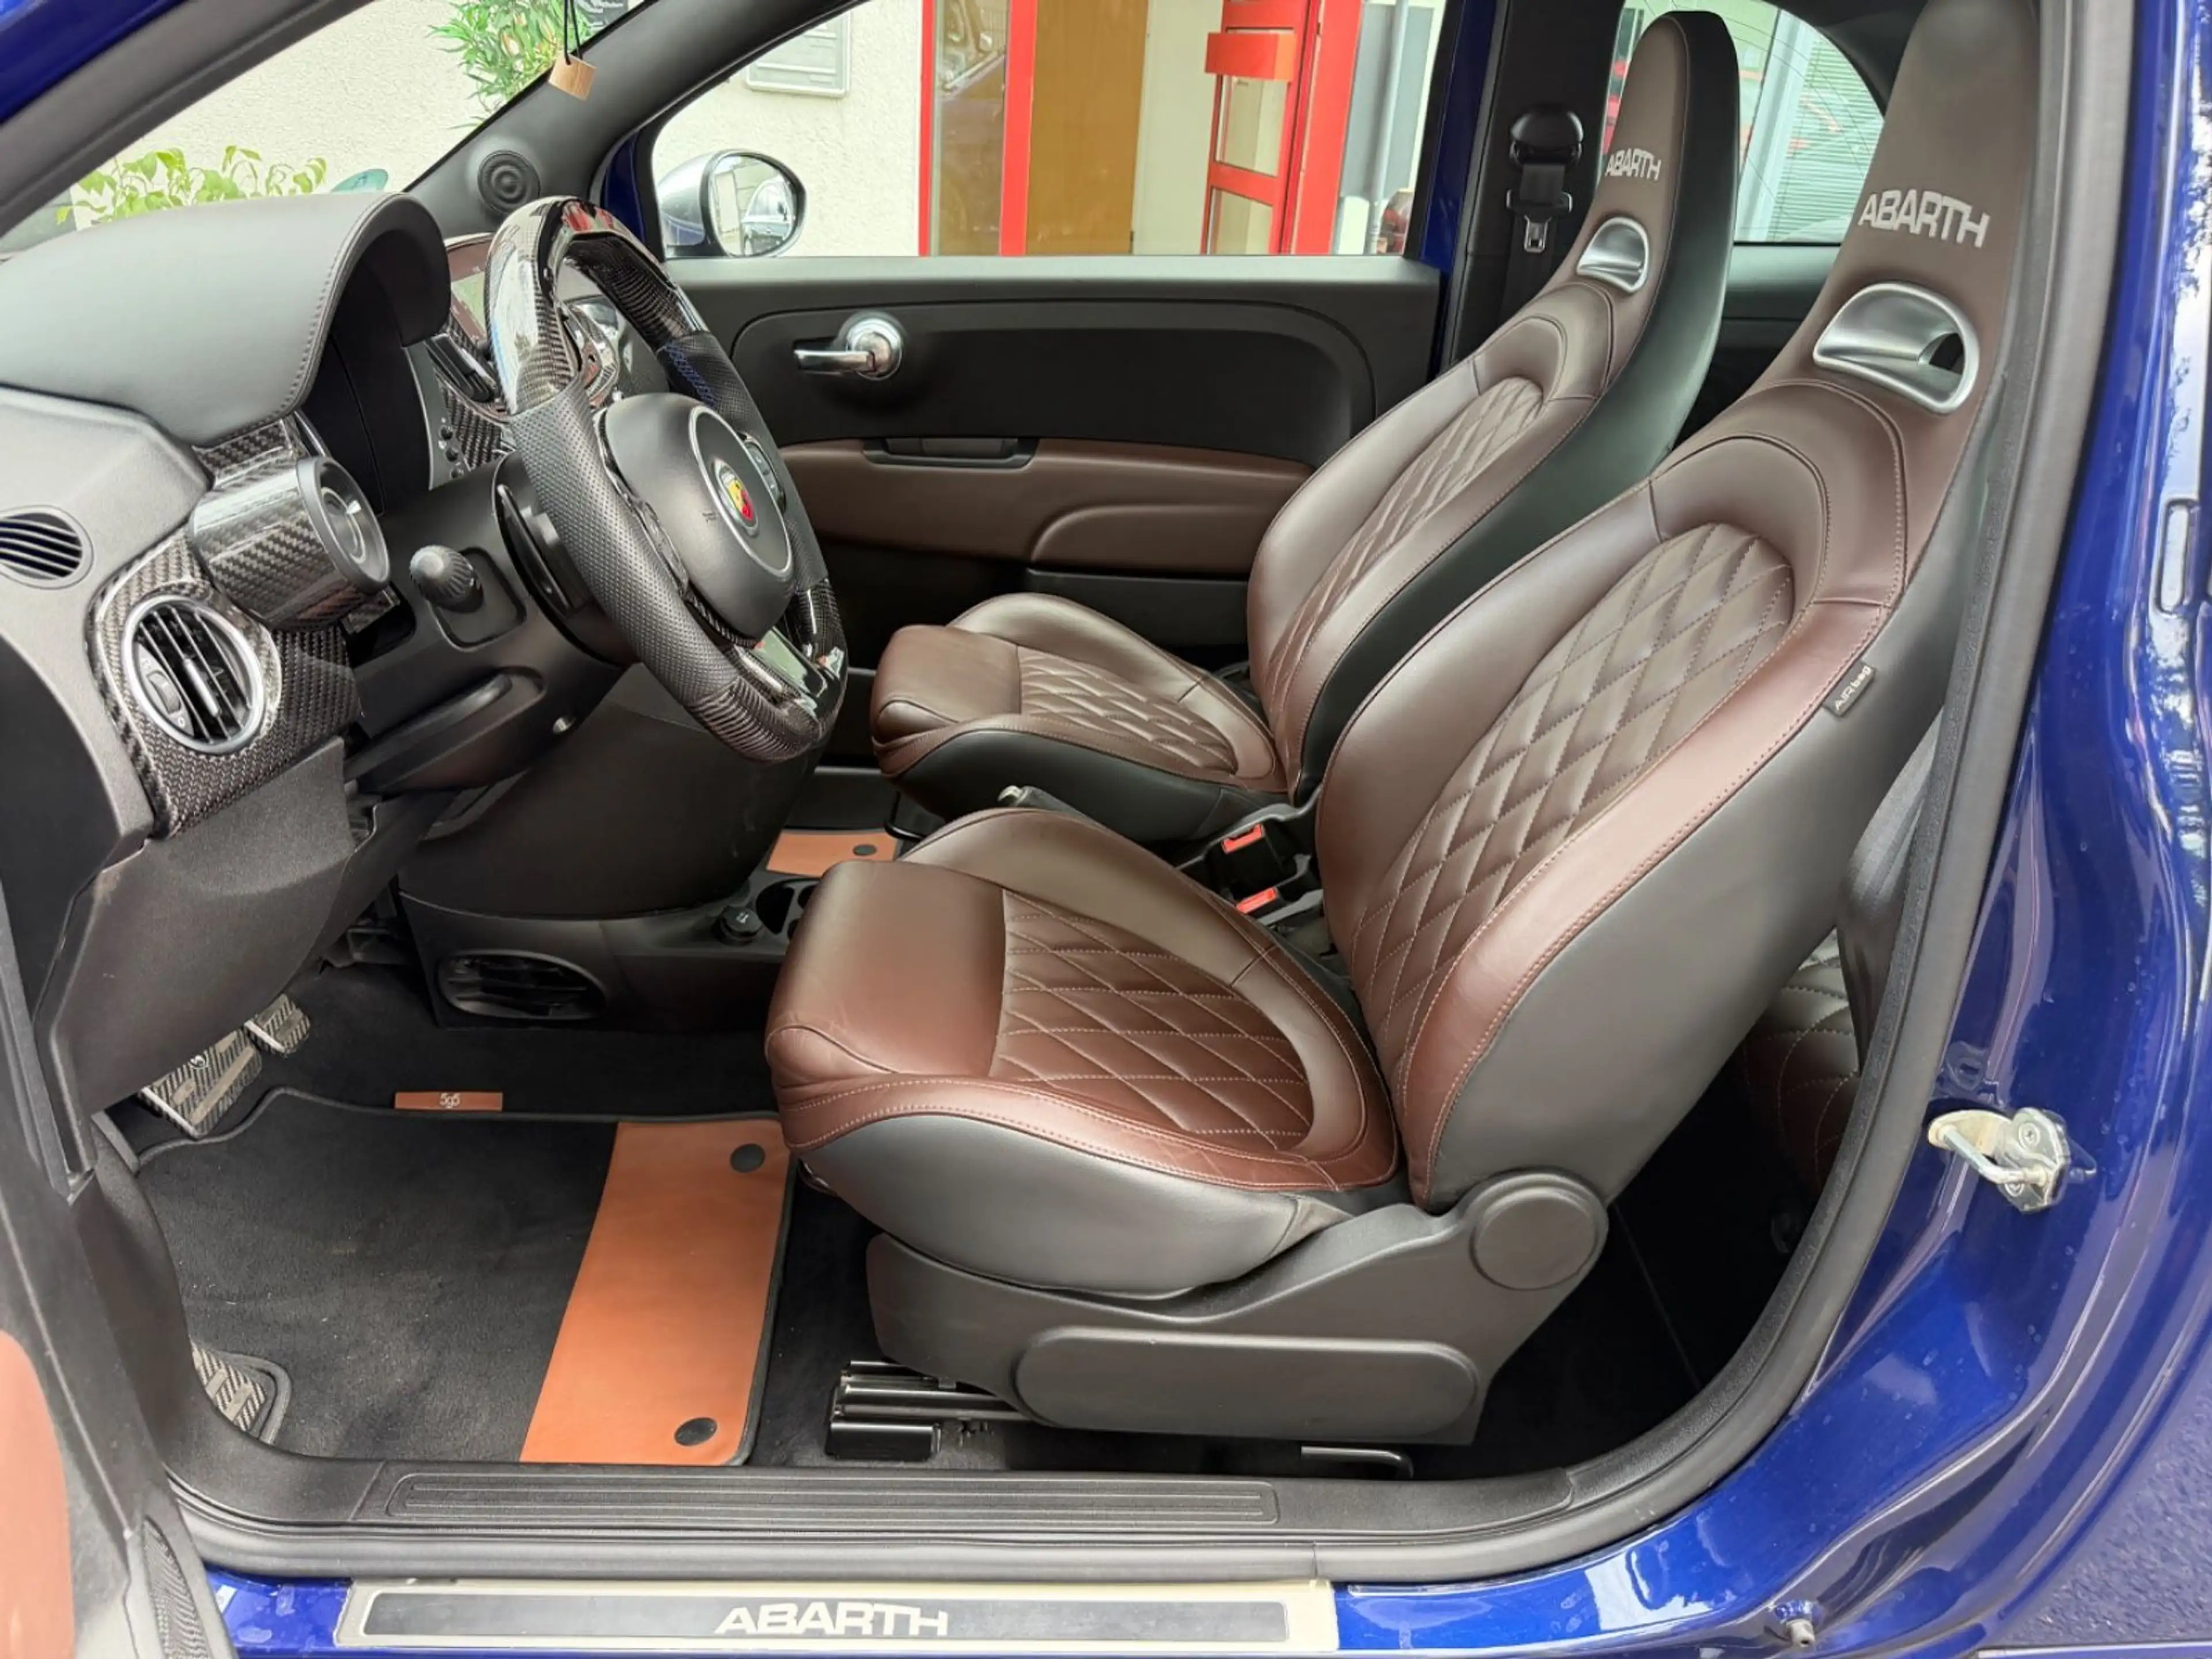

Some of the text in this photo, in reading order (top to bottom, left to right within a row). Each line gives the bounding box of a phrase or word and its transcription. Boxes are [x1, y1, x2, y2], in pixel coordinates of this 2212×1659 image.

[1605, 148, 1661, 181] ABARTH
[1858, 188, 1991, 248] ABARTH
[714, 1601, 948, 1636] ABARTH
